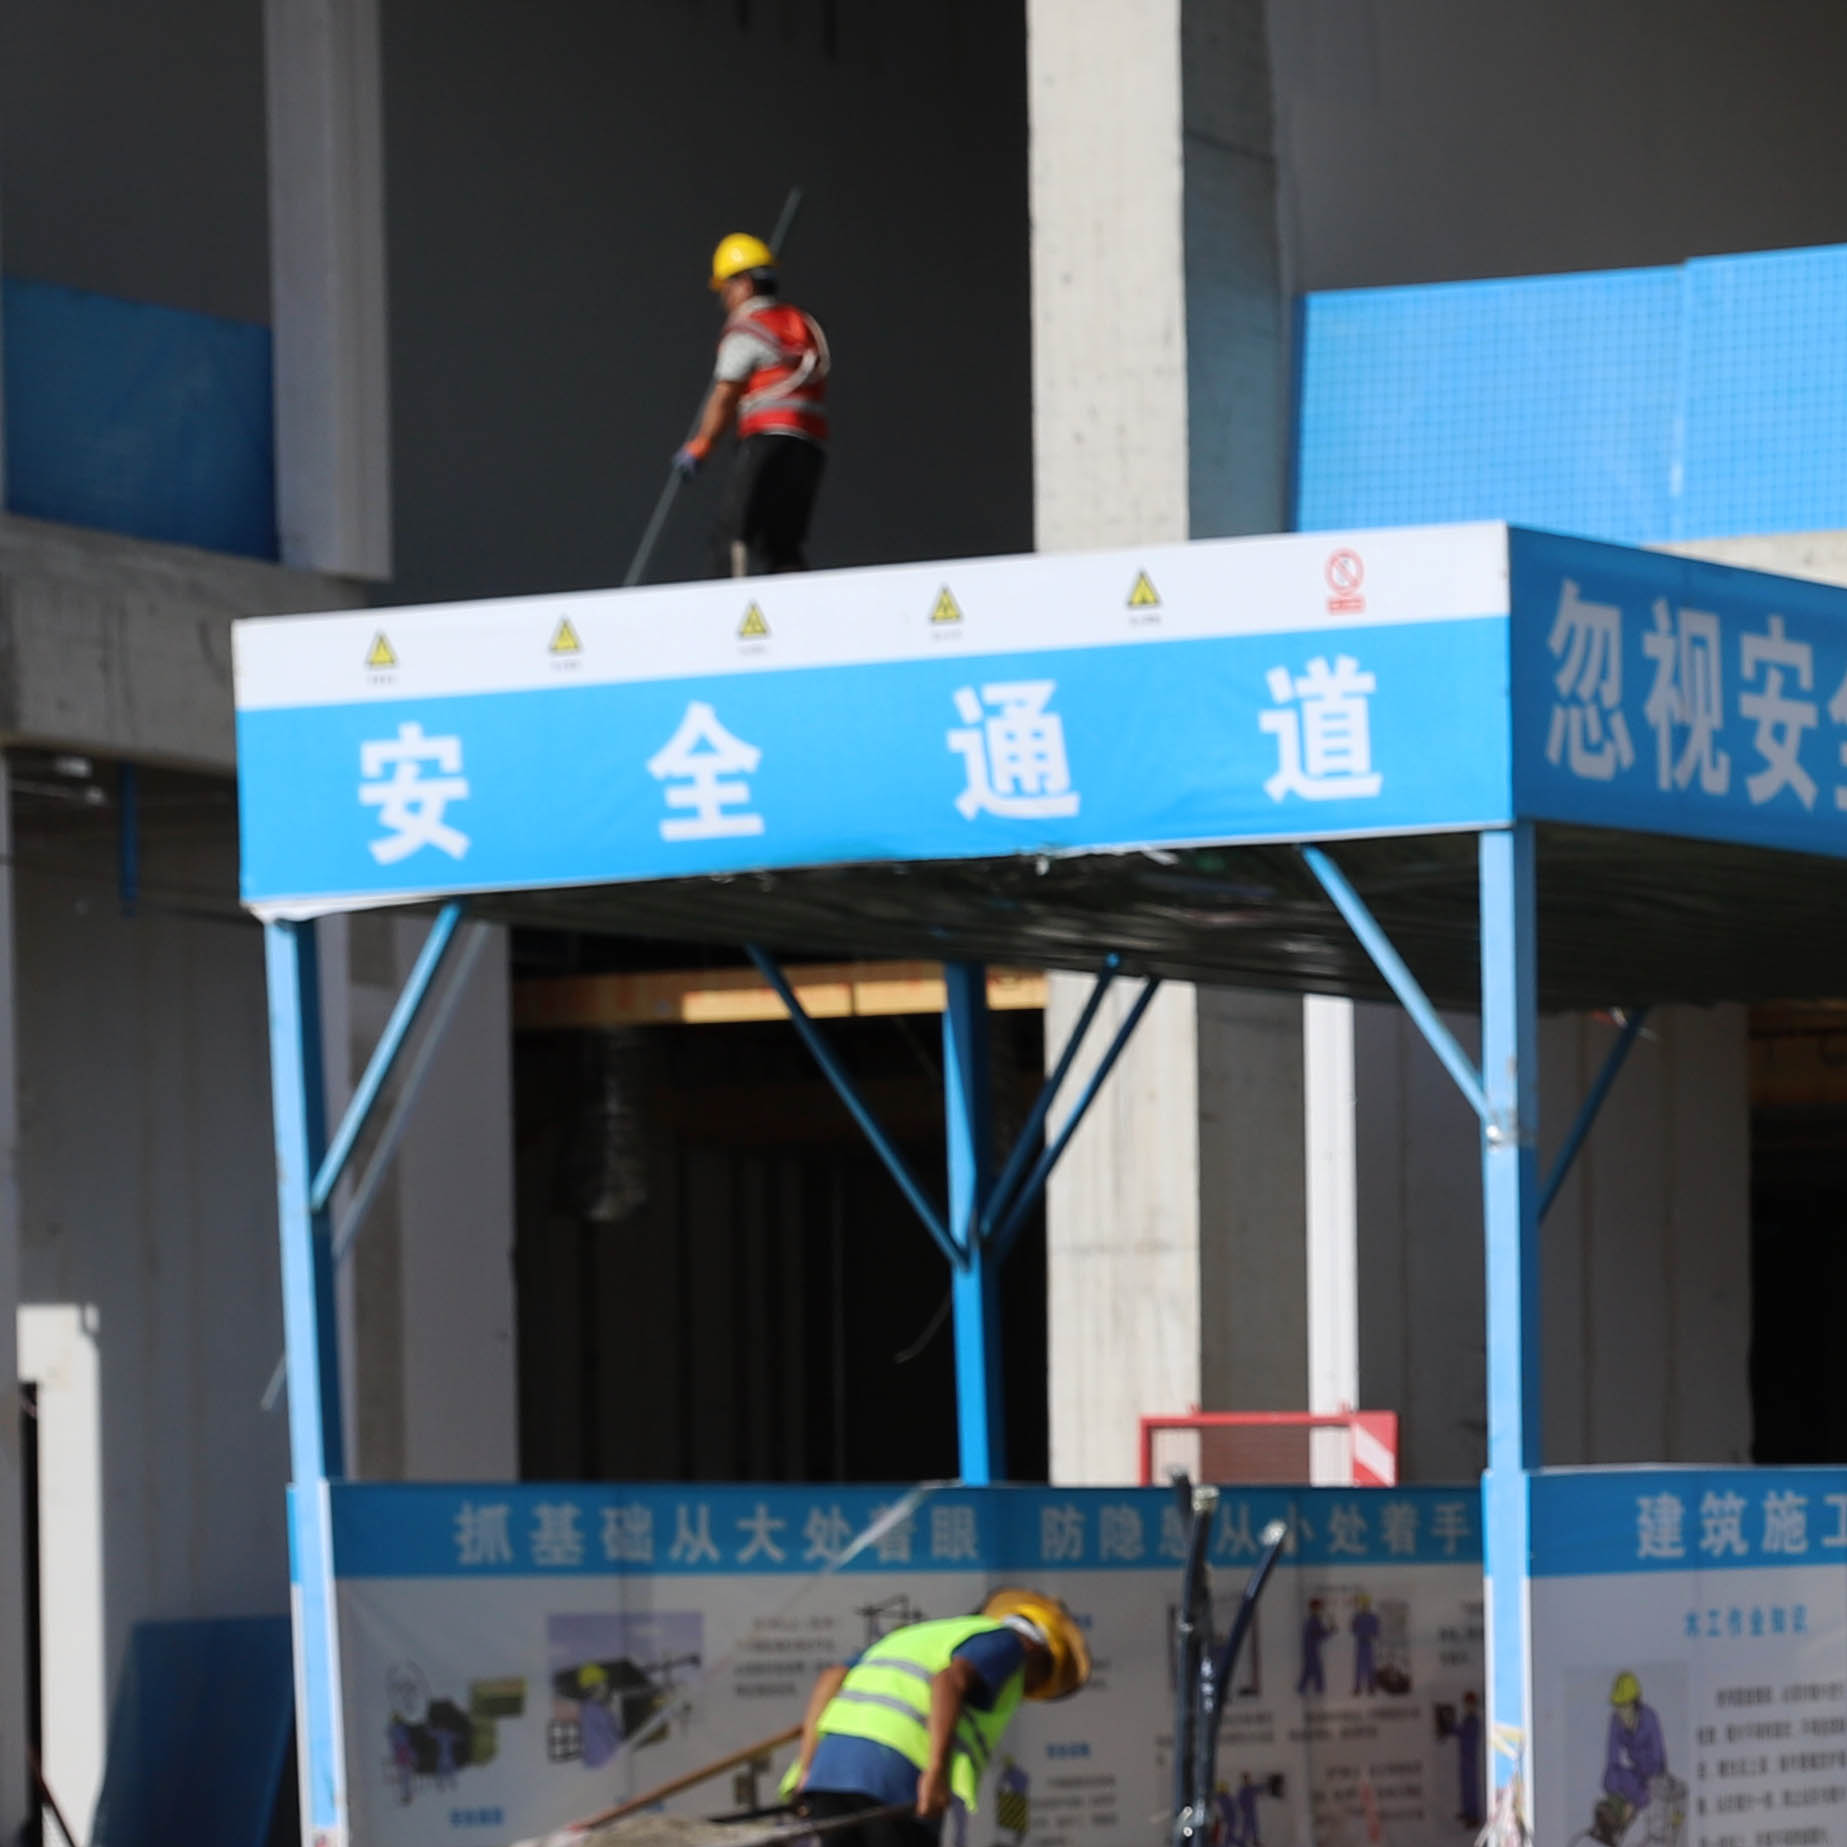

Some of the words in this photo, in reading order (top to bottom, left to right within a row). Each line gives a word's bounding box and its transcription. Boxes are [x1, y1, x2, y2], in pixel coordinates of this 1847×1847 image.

[358, 655, 1384, 866] 安全通道
[454, 1501, 979, 1567] 抓基础从大处着眼
